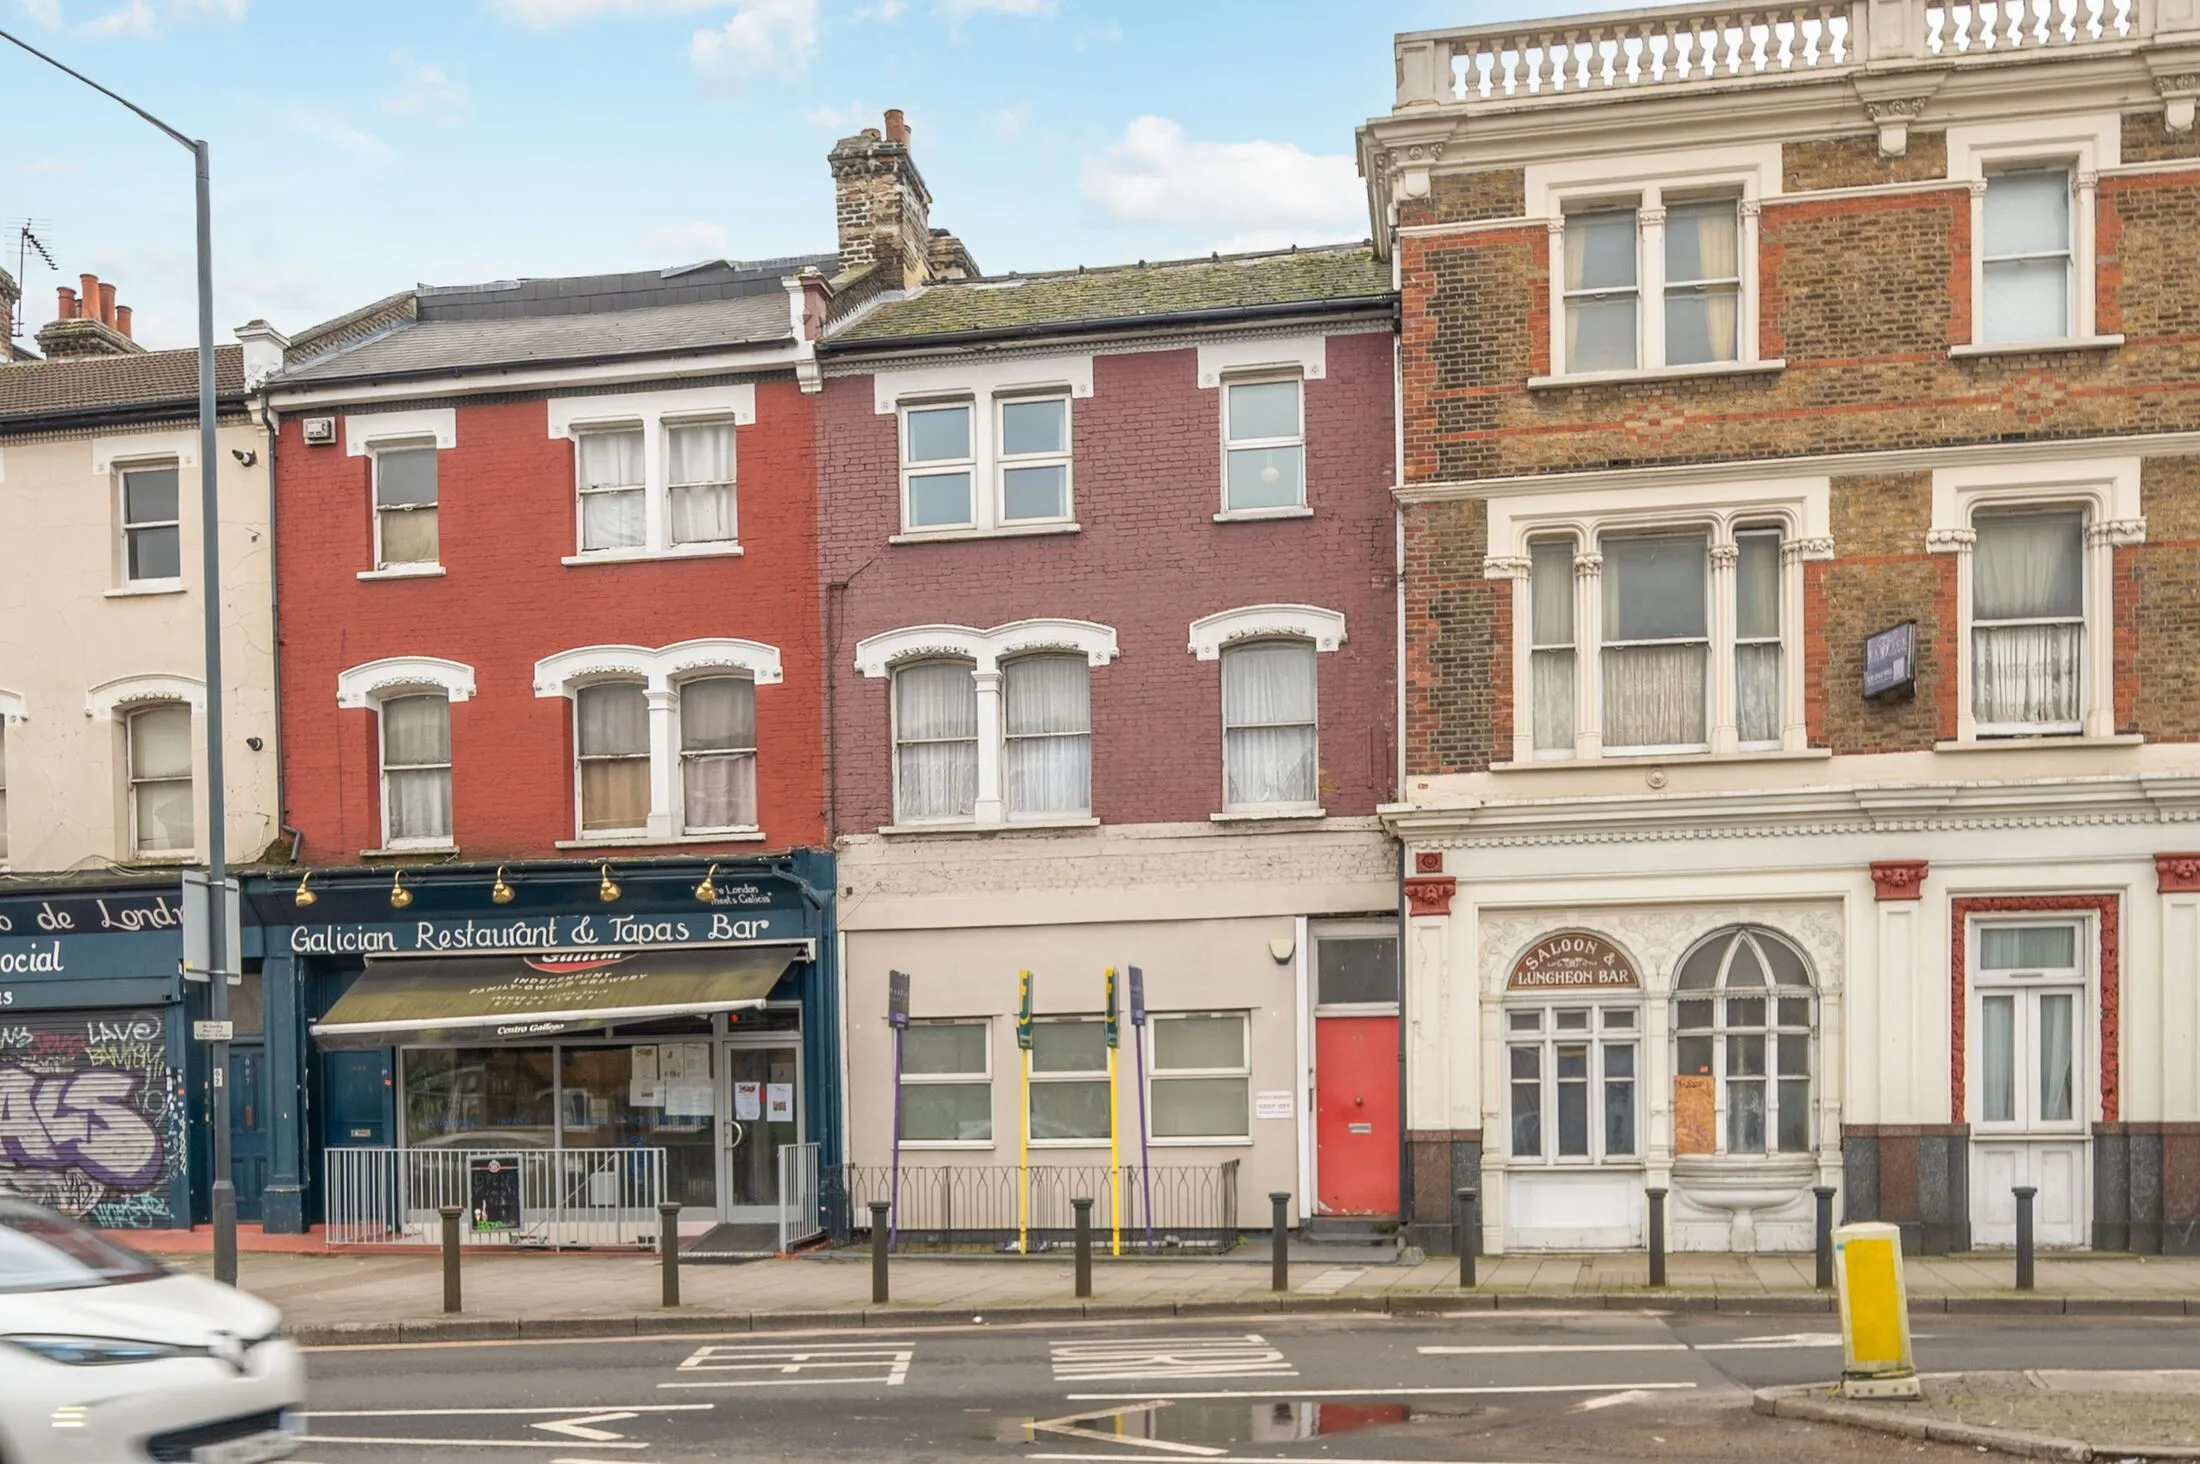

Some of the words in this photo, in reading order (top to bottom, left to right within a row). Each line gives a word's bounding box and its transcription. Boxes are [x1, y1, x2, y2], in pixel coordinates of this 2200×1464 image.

[725, 884, 758, 894] London
[37, 902, 75, 931] de
[290, 924, 399, 954] Galician
[415, 917, 558, 951] Restaurant
[571, 915, 599, 944] &
[609, 914, 690, 945] Tapas
[708, 914, 770, 940] Bar
[1525, 938, 1598, 970] SALOON
[1603, 952, 1616, 966] &
[468, 981, 574, 995] FAMILY-OWNED
[579, 973, 648, 985] BREWERY
[513, 972, 613, 984] INDEPENDENT
[1599, 969, 1629, 983] BAR
[497, 1025, 528, 1035] Centro
